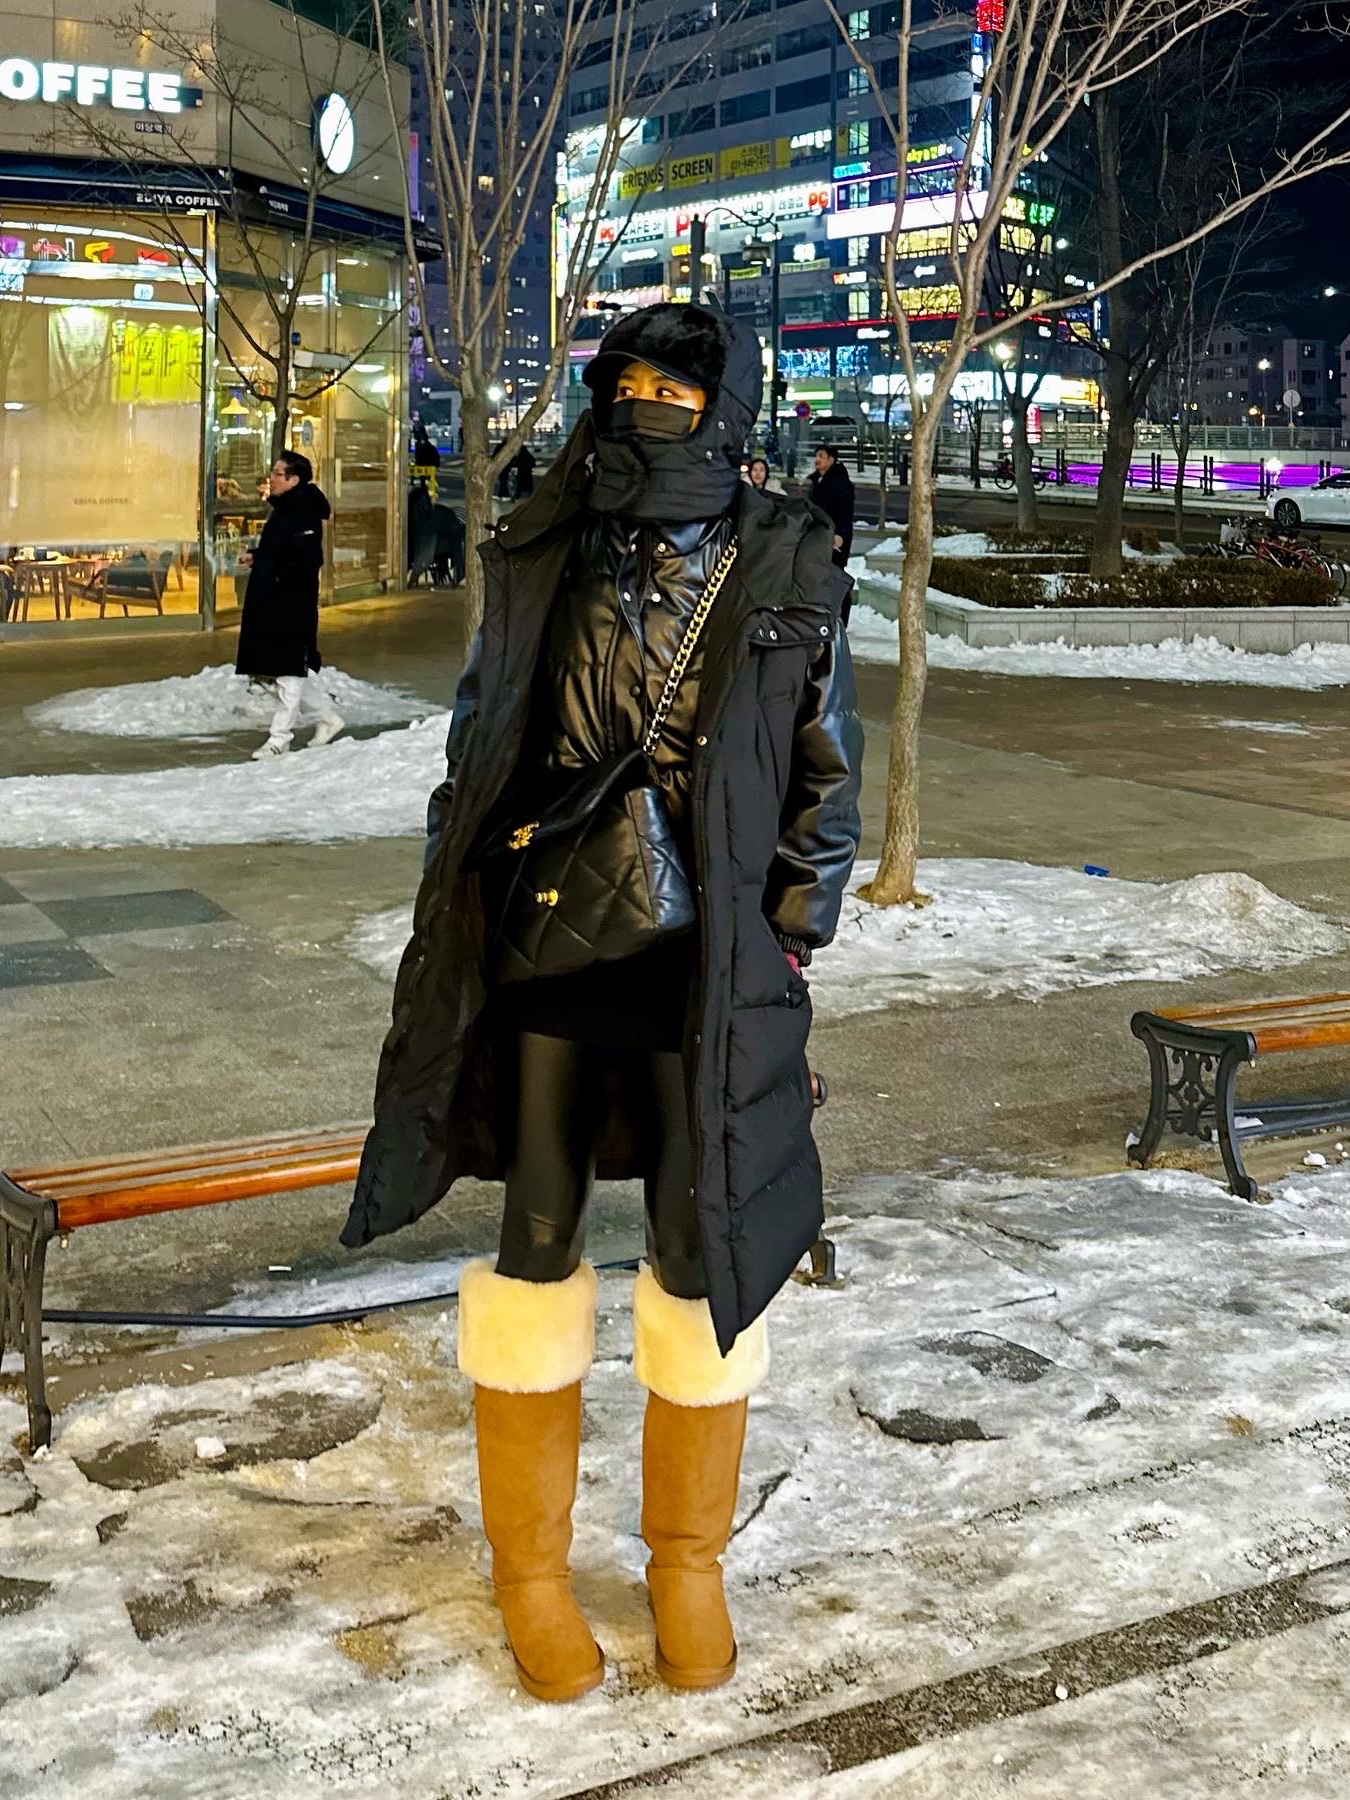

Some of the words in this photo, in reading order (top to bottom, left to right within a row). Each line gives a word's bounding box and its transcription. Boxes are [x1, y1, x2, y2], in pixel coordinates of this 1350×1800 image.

[0, 58, 182, 113] OFFEE
[622, 167, 664, 190] FRIENDS
[671, 157, 713, 180] SCREEN
[808, 190, 829, 209] PC
